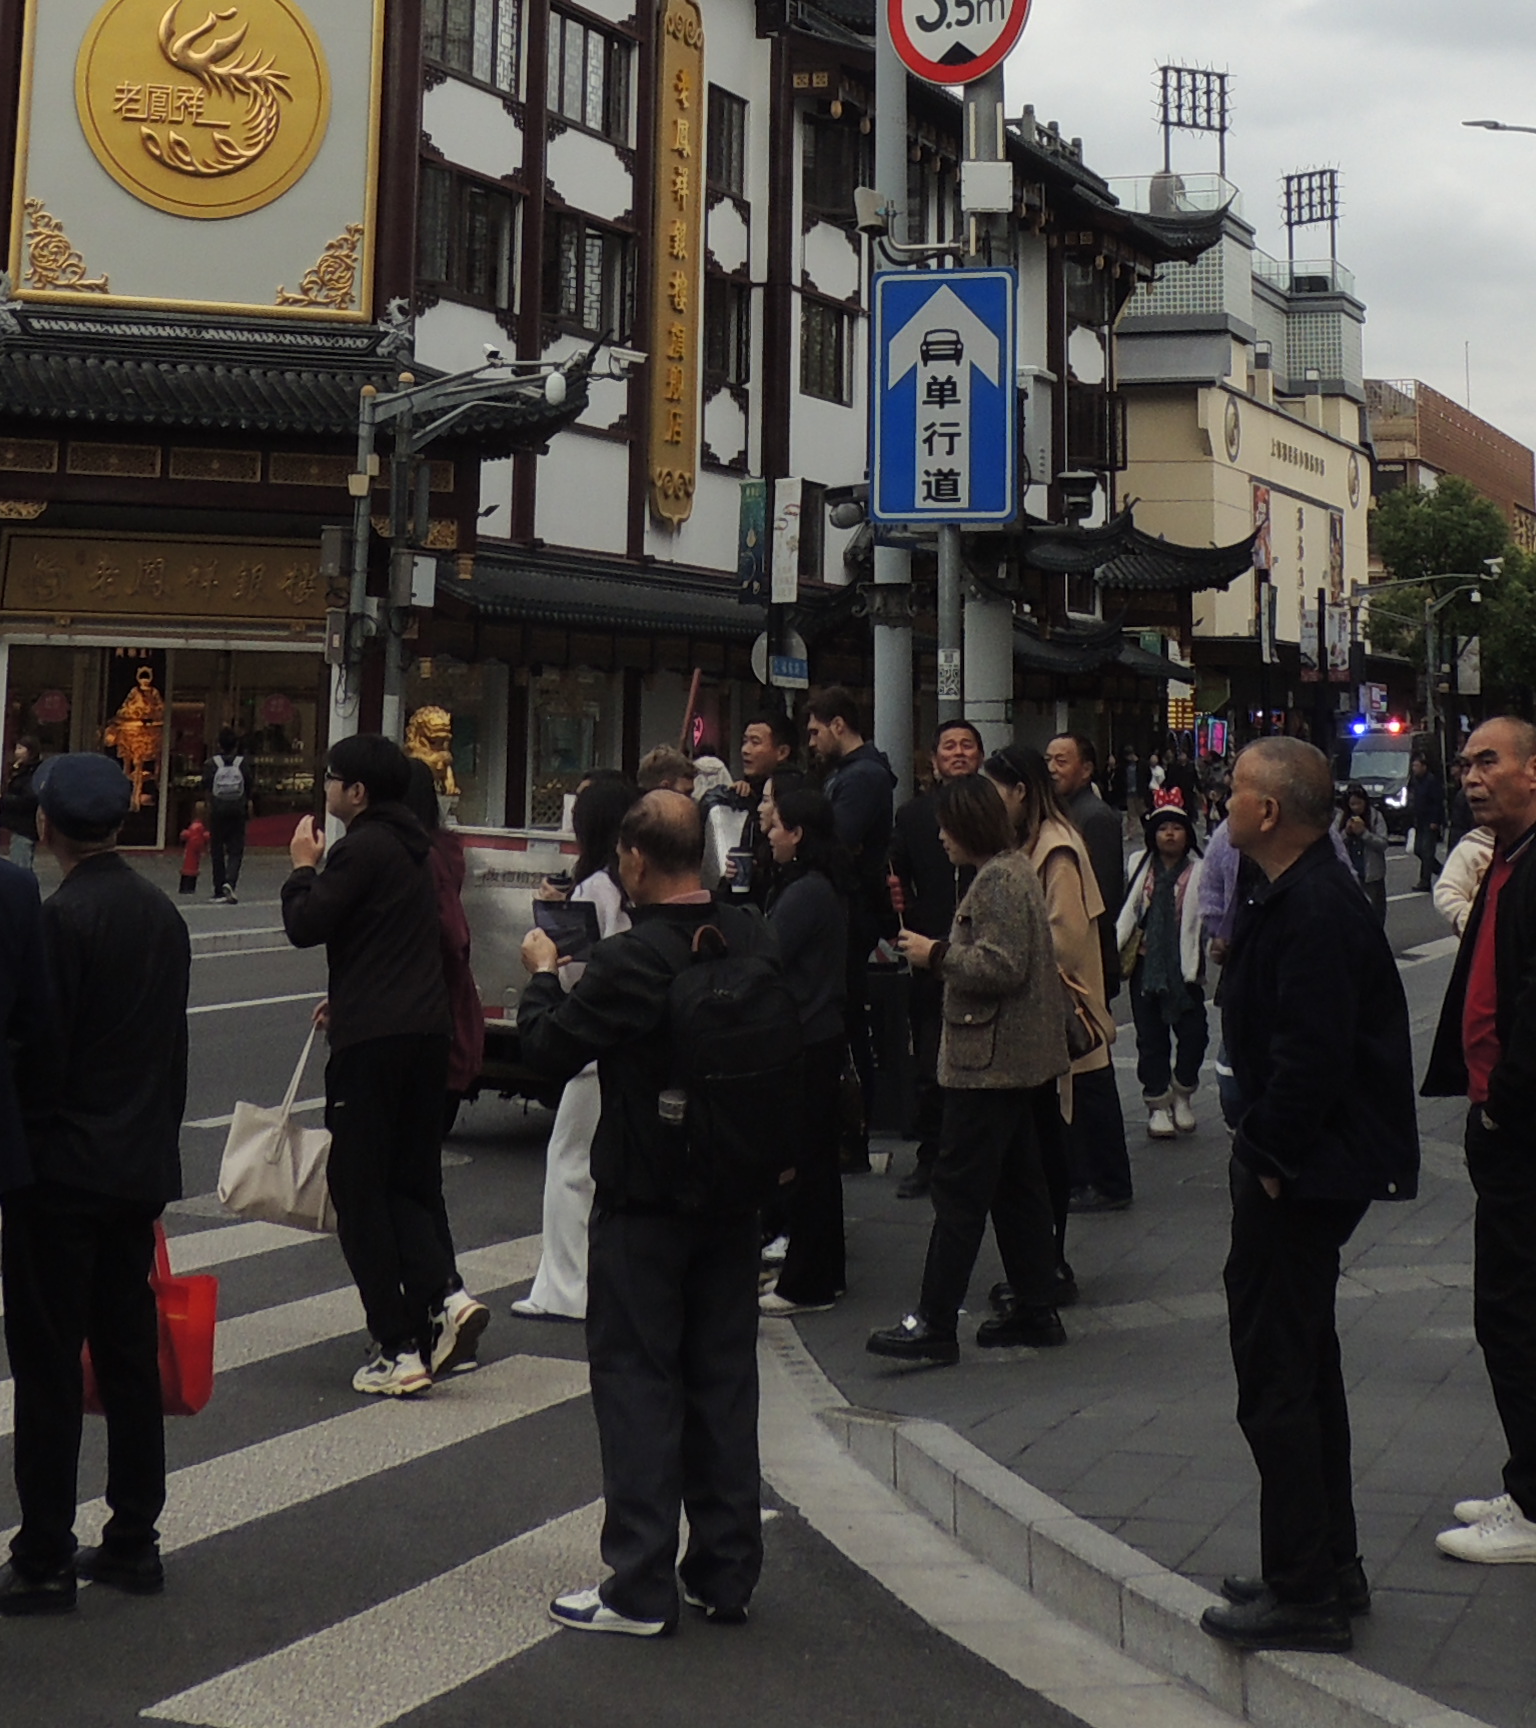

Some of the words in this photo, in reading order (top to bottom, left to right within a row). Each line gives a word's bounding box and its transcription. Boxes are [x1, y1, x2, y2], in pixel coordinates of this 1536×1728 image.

[113, 81, 230, 128] 老鳳祥
[922, 375, 962, 503] 单行道
